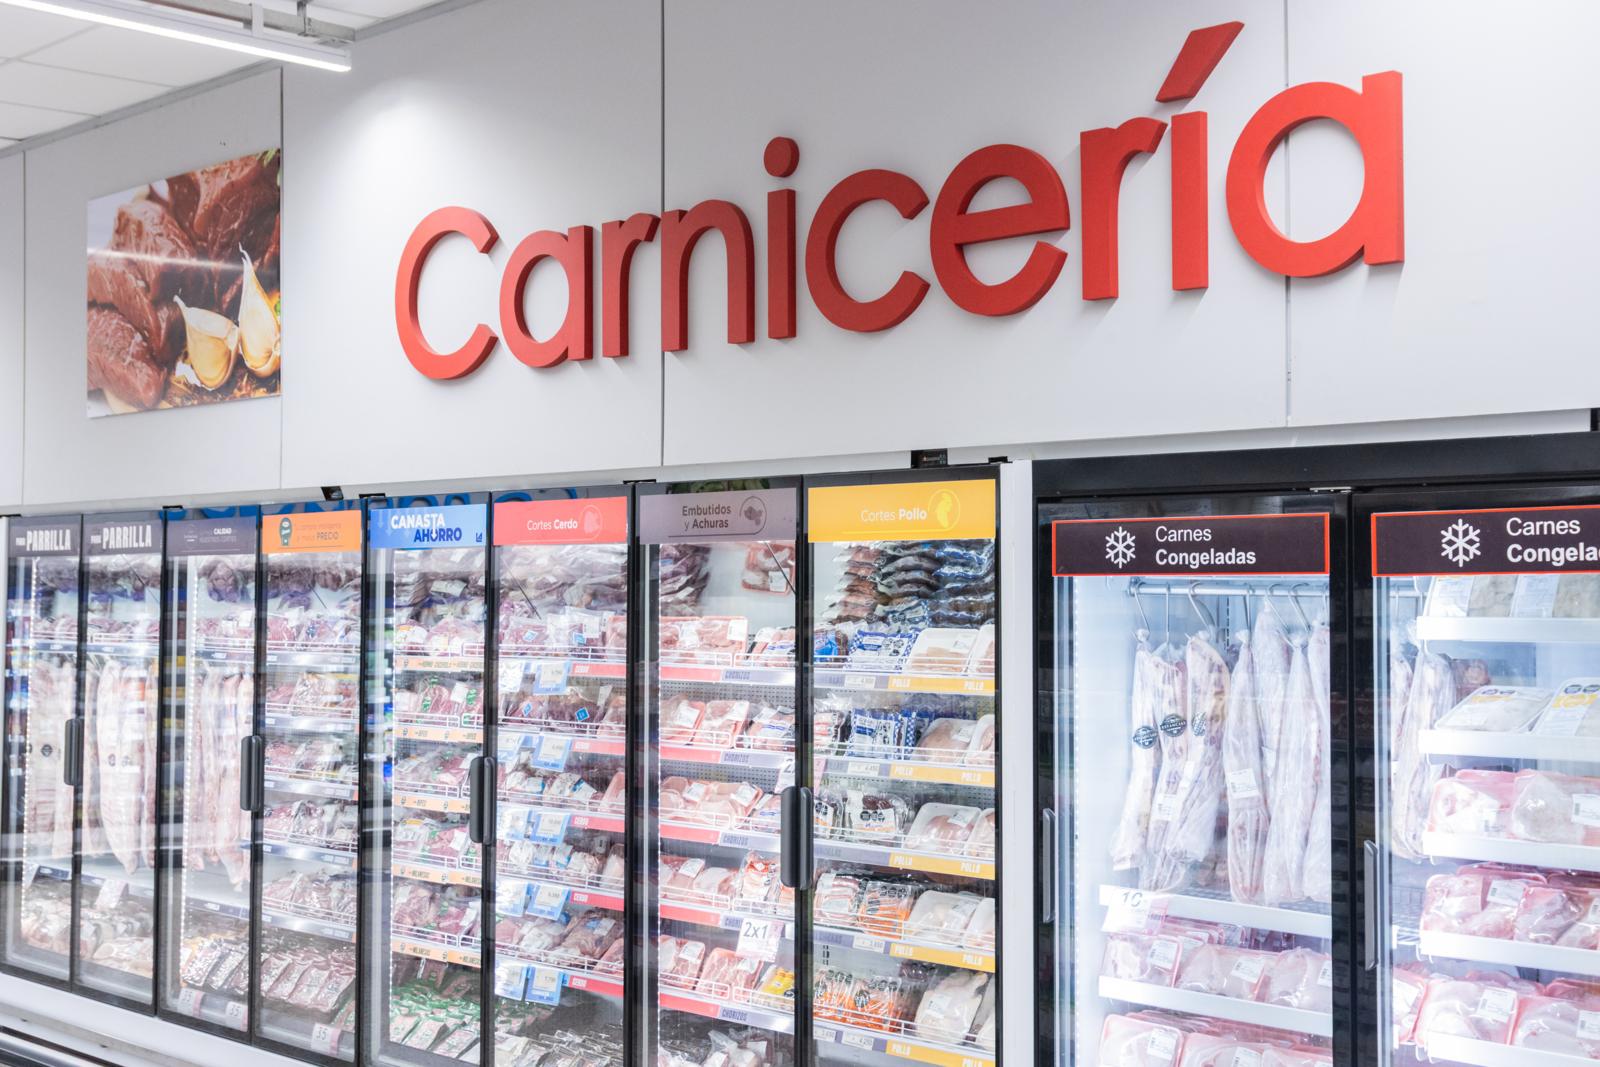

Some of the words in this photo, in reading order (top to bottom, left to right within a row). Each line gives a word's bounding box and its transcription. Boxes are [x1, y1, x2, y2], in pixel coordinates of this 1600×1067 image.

[395, 21, 1405, 380] Carnicería
[682, 503, 732, 518] Embutidos
[859, 508, 896, 523] Cortes
[898, 507, 928, 522] Pollo
[390, 512, 446, 530] CANASTA
[527, 520, 552, 531] Cortes
[683, 519, 690, 533] y
[692, 516, 729, 531] Achuras
[1506, 517, 1581, 536] Carnes
[26, 527, 72, 552] PARRILLA
[102, 524, 153, 550] PARRILLA
[413, 527, 463, 543] AHORRO
[1155, 525, 1213, 543] Carnes
[1155, 547, 1257, 570] Congeladas
[1506, 542, 1600, 567] Congela
[744, 921, 769, 939] 2x1
